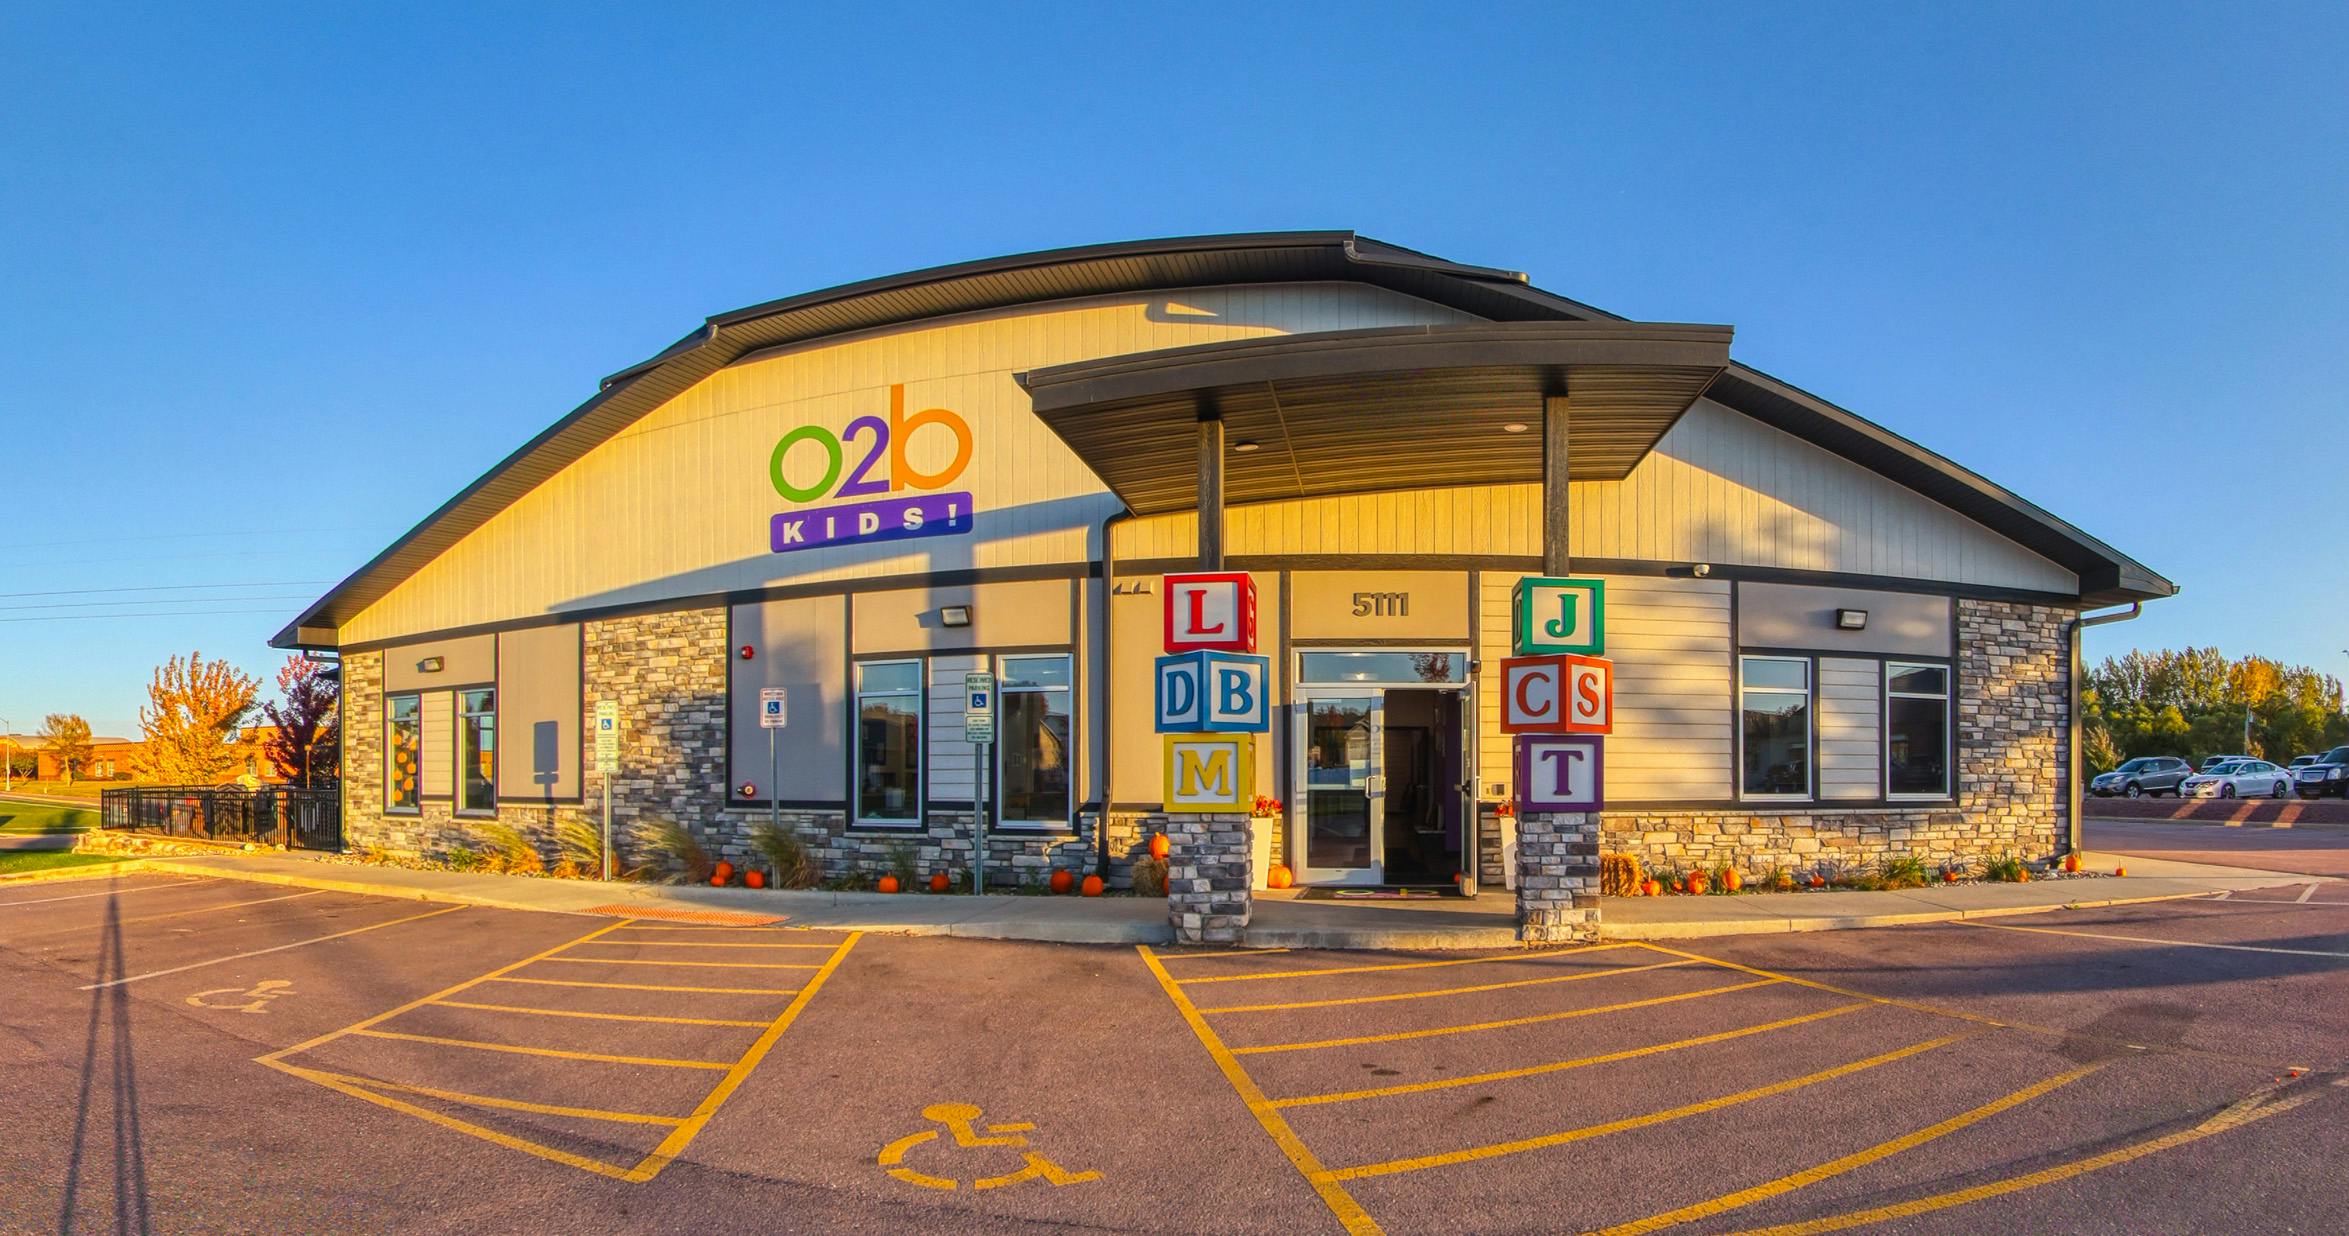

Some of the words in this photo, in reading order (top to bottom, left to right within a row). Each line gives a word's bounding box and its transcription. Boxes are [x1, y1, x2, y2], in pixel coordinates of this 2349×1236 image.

[770, 384, 973, 503] o2b
[783, 504, 957, 544] KIDS!
[1186, 590, 1224, 634] L
[1352, 592, 1409, 617] 5111
[1545, 594, 1579, 637] J
[1166, 671, 1194, 716] D
[1219, 669, 1253, 714] B
[1516, 672, 1551, 717] C
[1577, 672, 1599, 717] S
[1177, 750, 1232, 796] M
[1542, 750, 1584, 796] T
